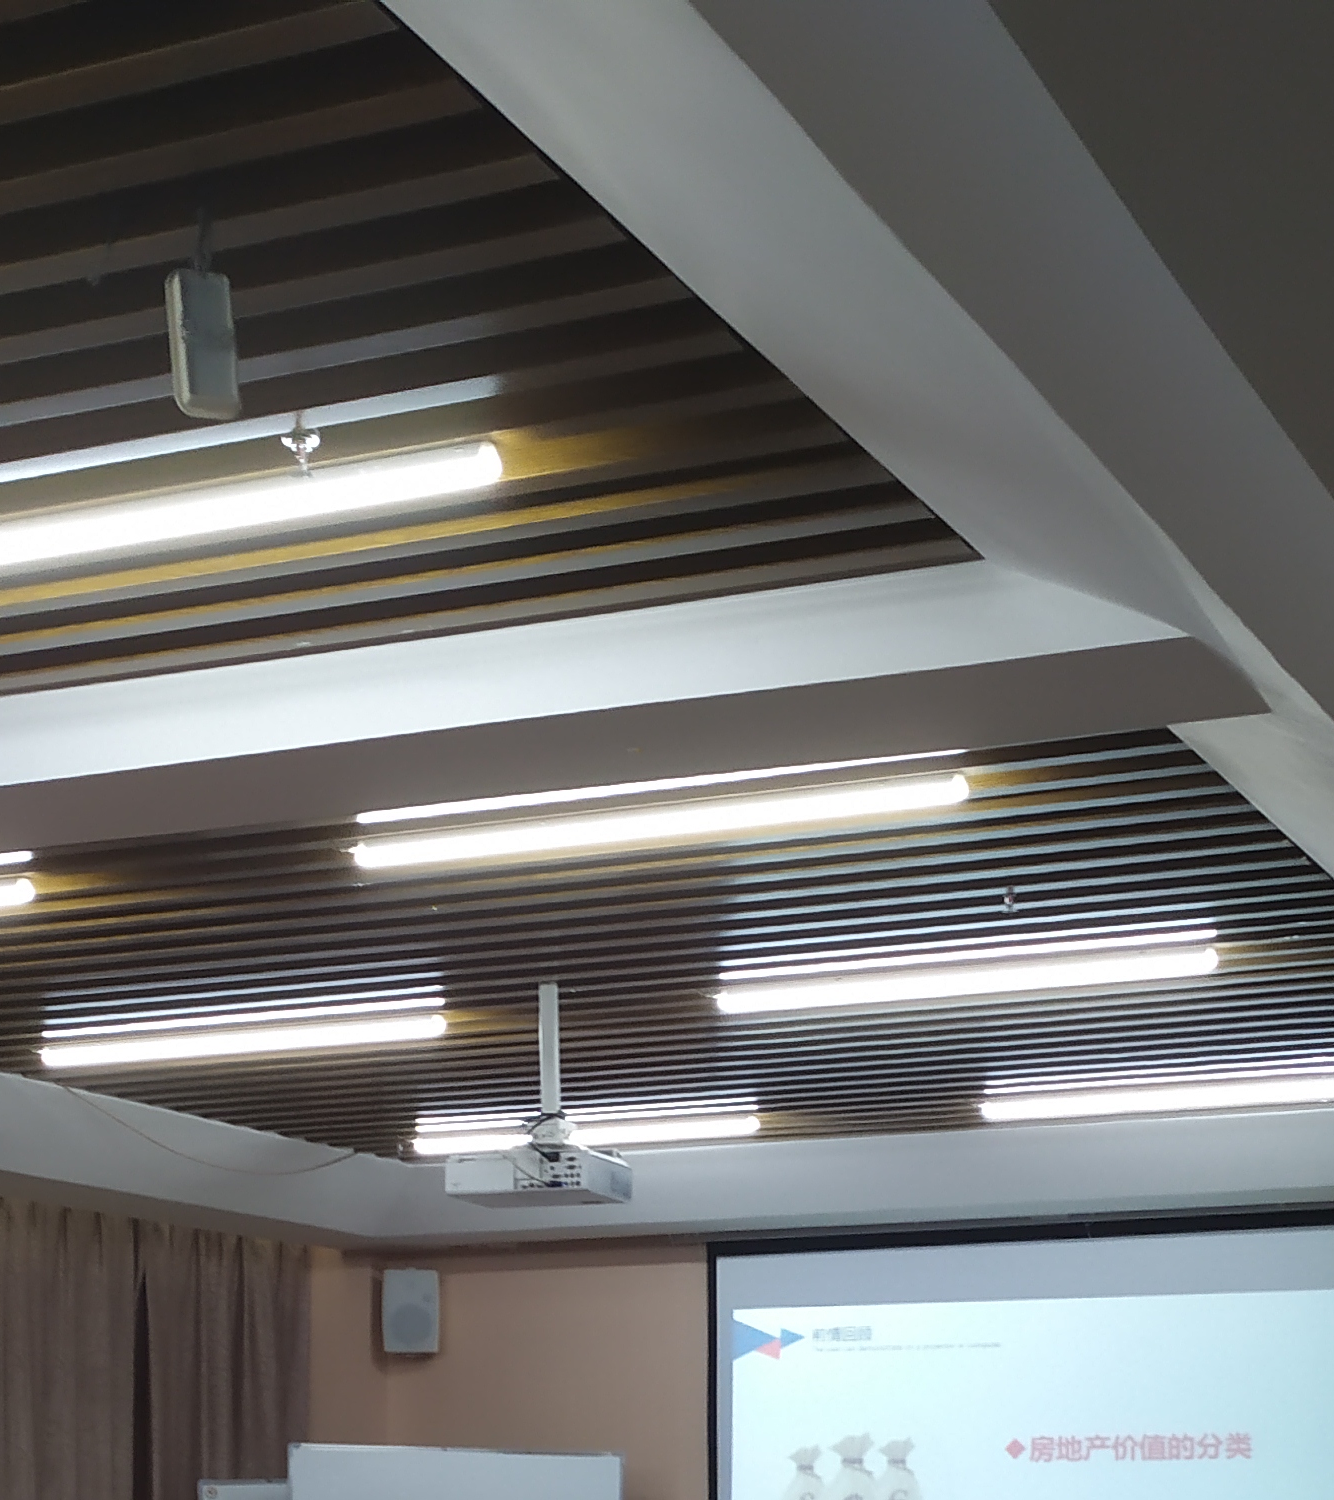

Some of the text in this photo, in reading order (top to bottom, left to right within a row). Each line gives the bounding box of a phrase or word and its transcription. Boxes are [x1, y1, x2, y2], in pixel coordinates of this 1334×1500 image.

[1029, 1433, 1253, 1462] 房地产价值的分类
